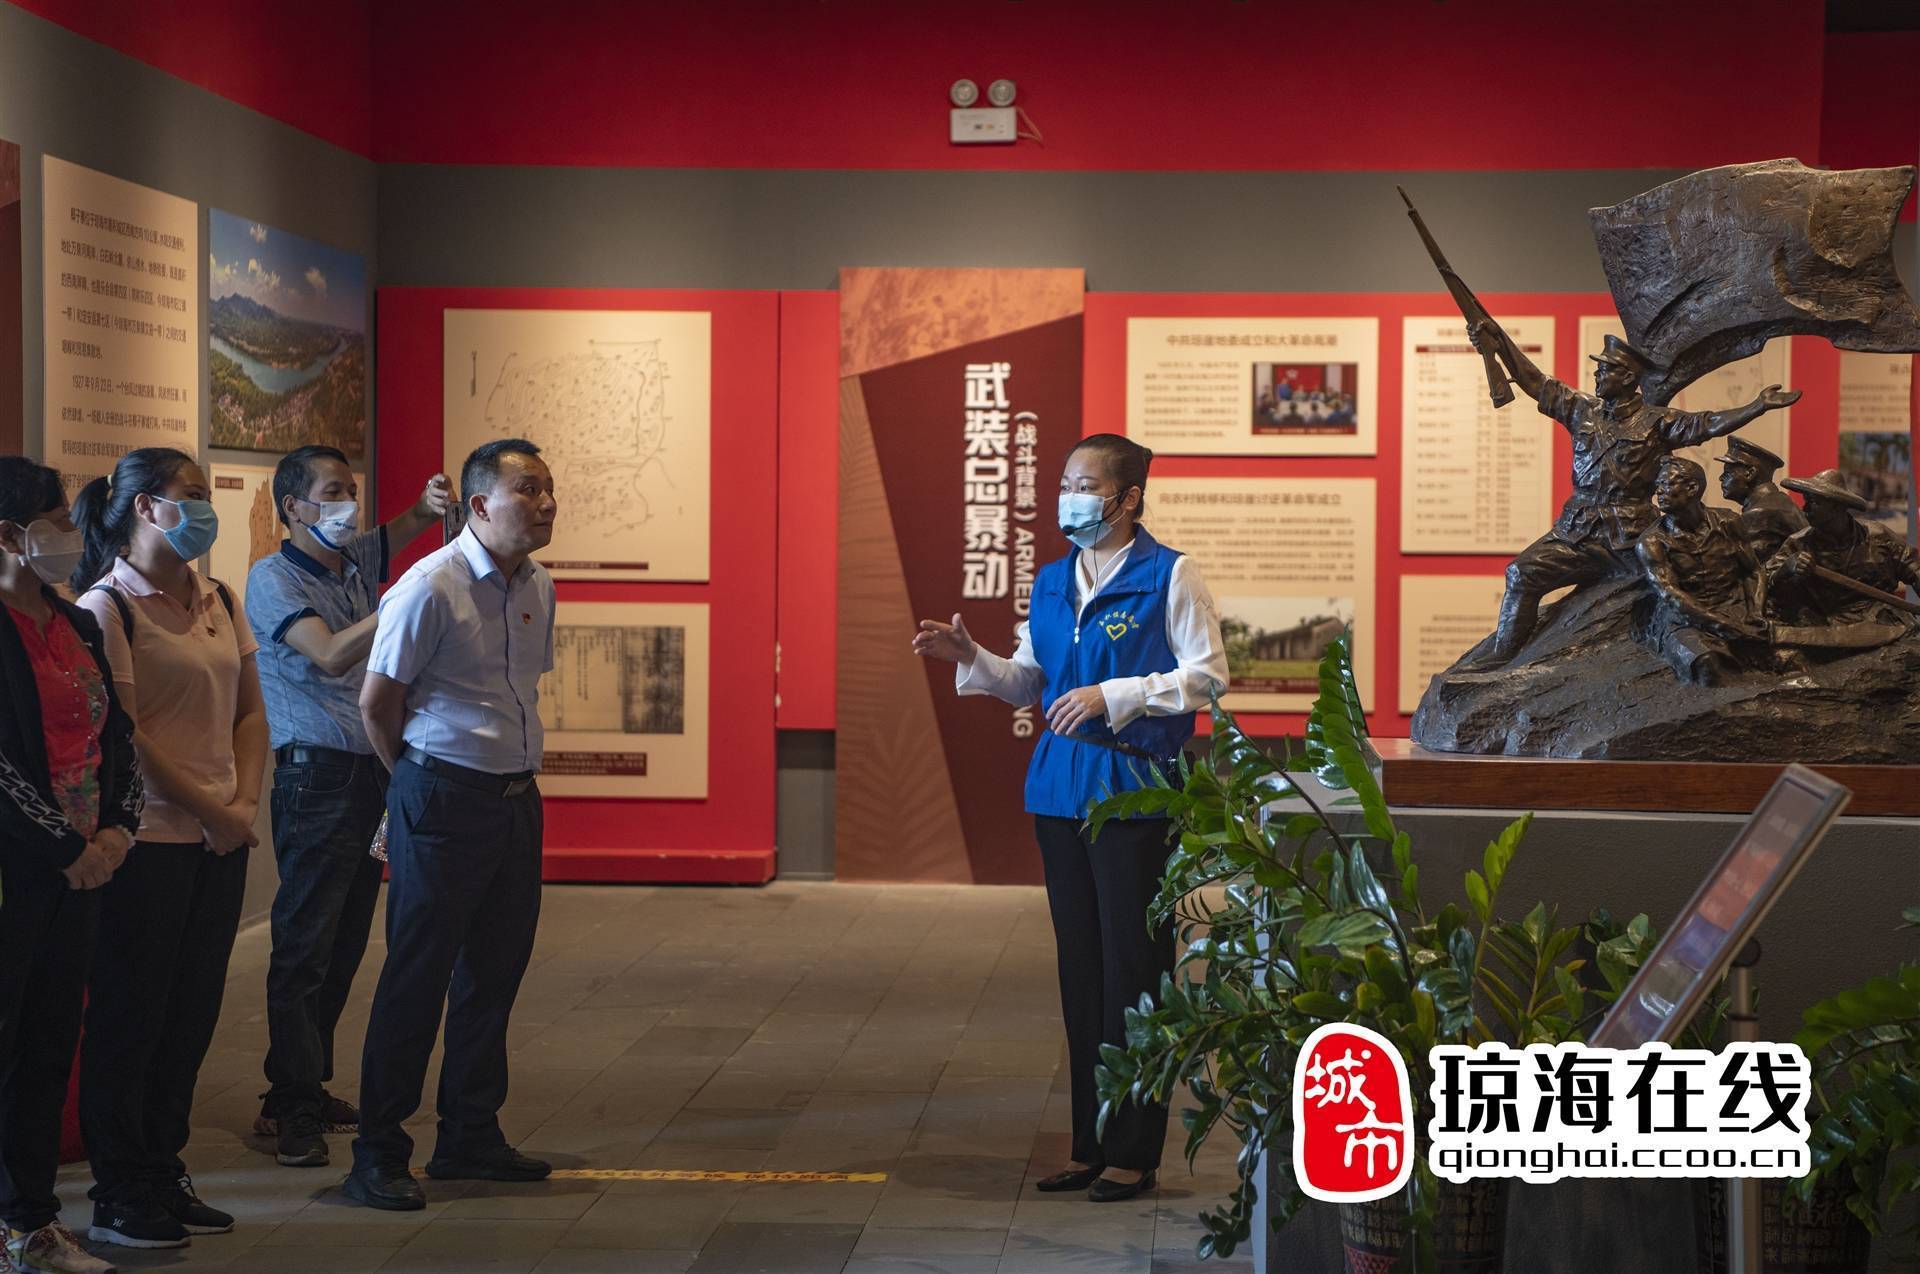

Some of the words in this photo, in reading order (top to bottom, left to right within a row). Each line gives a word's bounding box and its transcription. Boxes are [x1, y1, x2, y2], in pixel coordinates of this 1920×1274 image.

[964, 362, 1010, 599] 武装总暴动
[1014, 527, 1035, 617] ARMED
